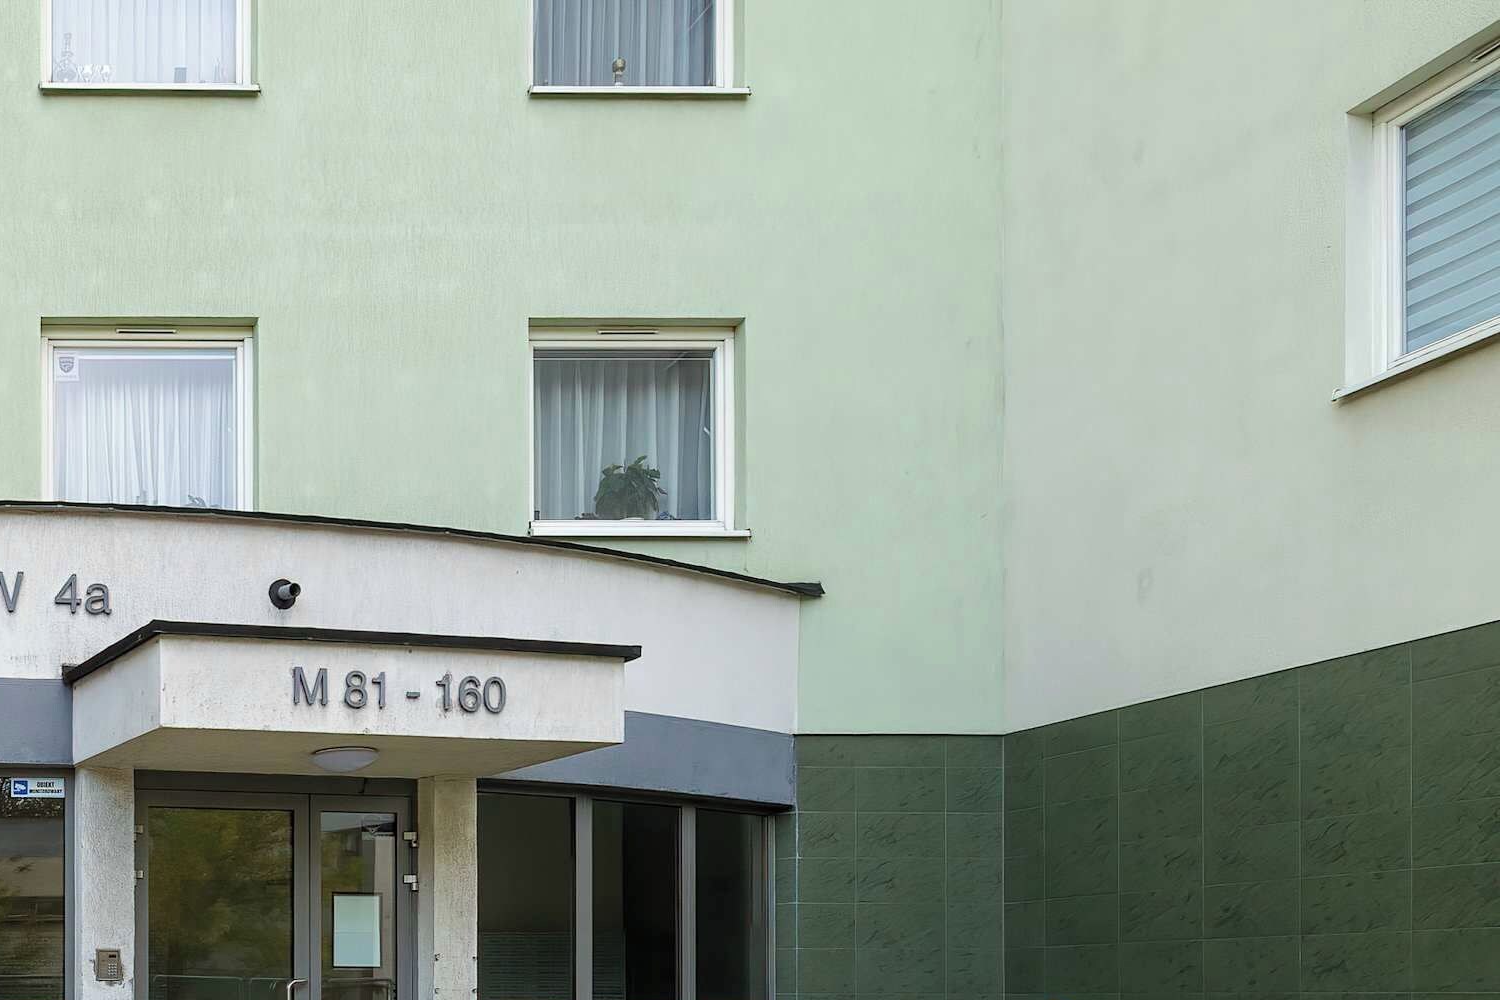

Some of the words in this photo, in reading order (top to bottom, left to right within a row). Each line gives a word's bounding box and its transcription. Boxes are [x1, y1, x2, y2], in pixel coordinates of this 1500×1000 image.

[54, 573, 112, 616] 4a
[293, 666, 328, 706] M
[344, 670, 386, 710] 81
[436, 673, 506, 713] 160
